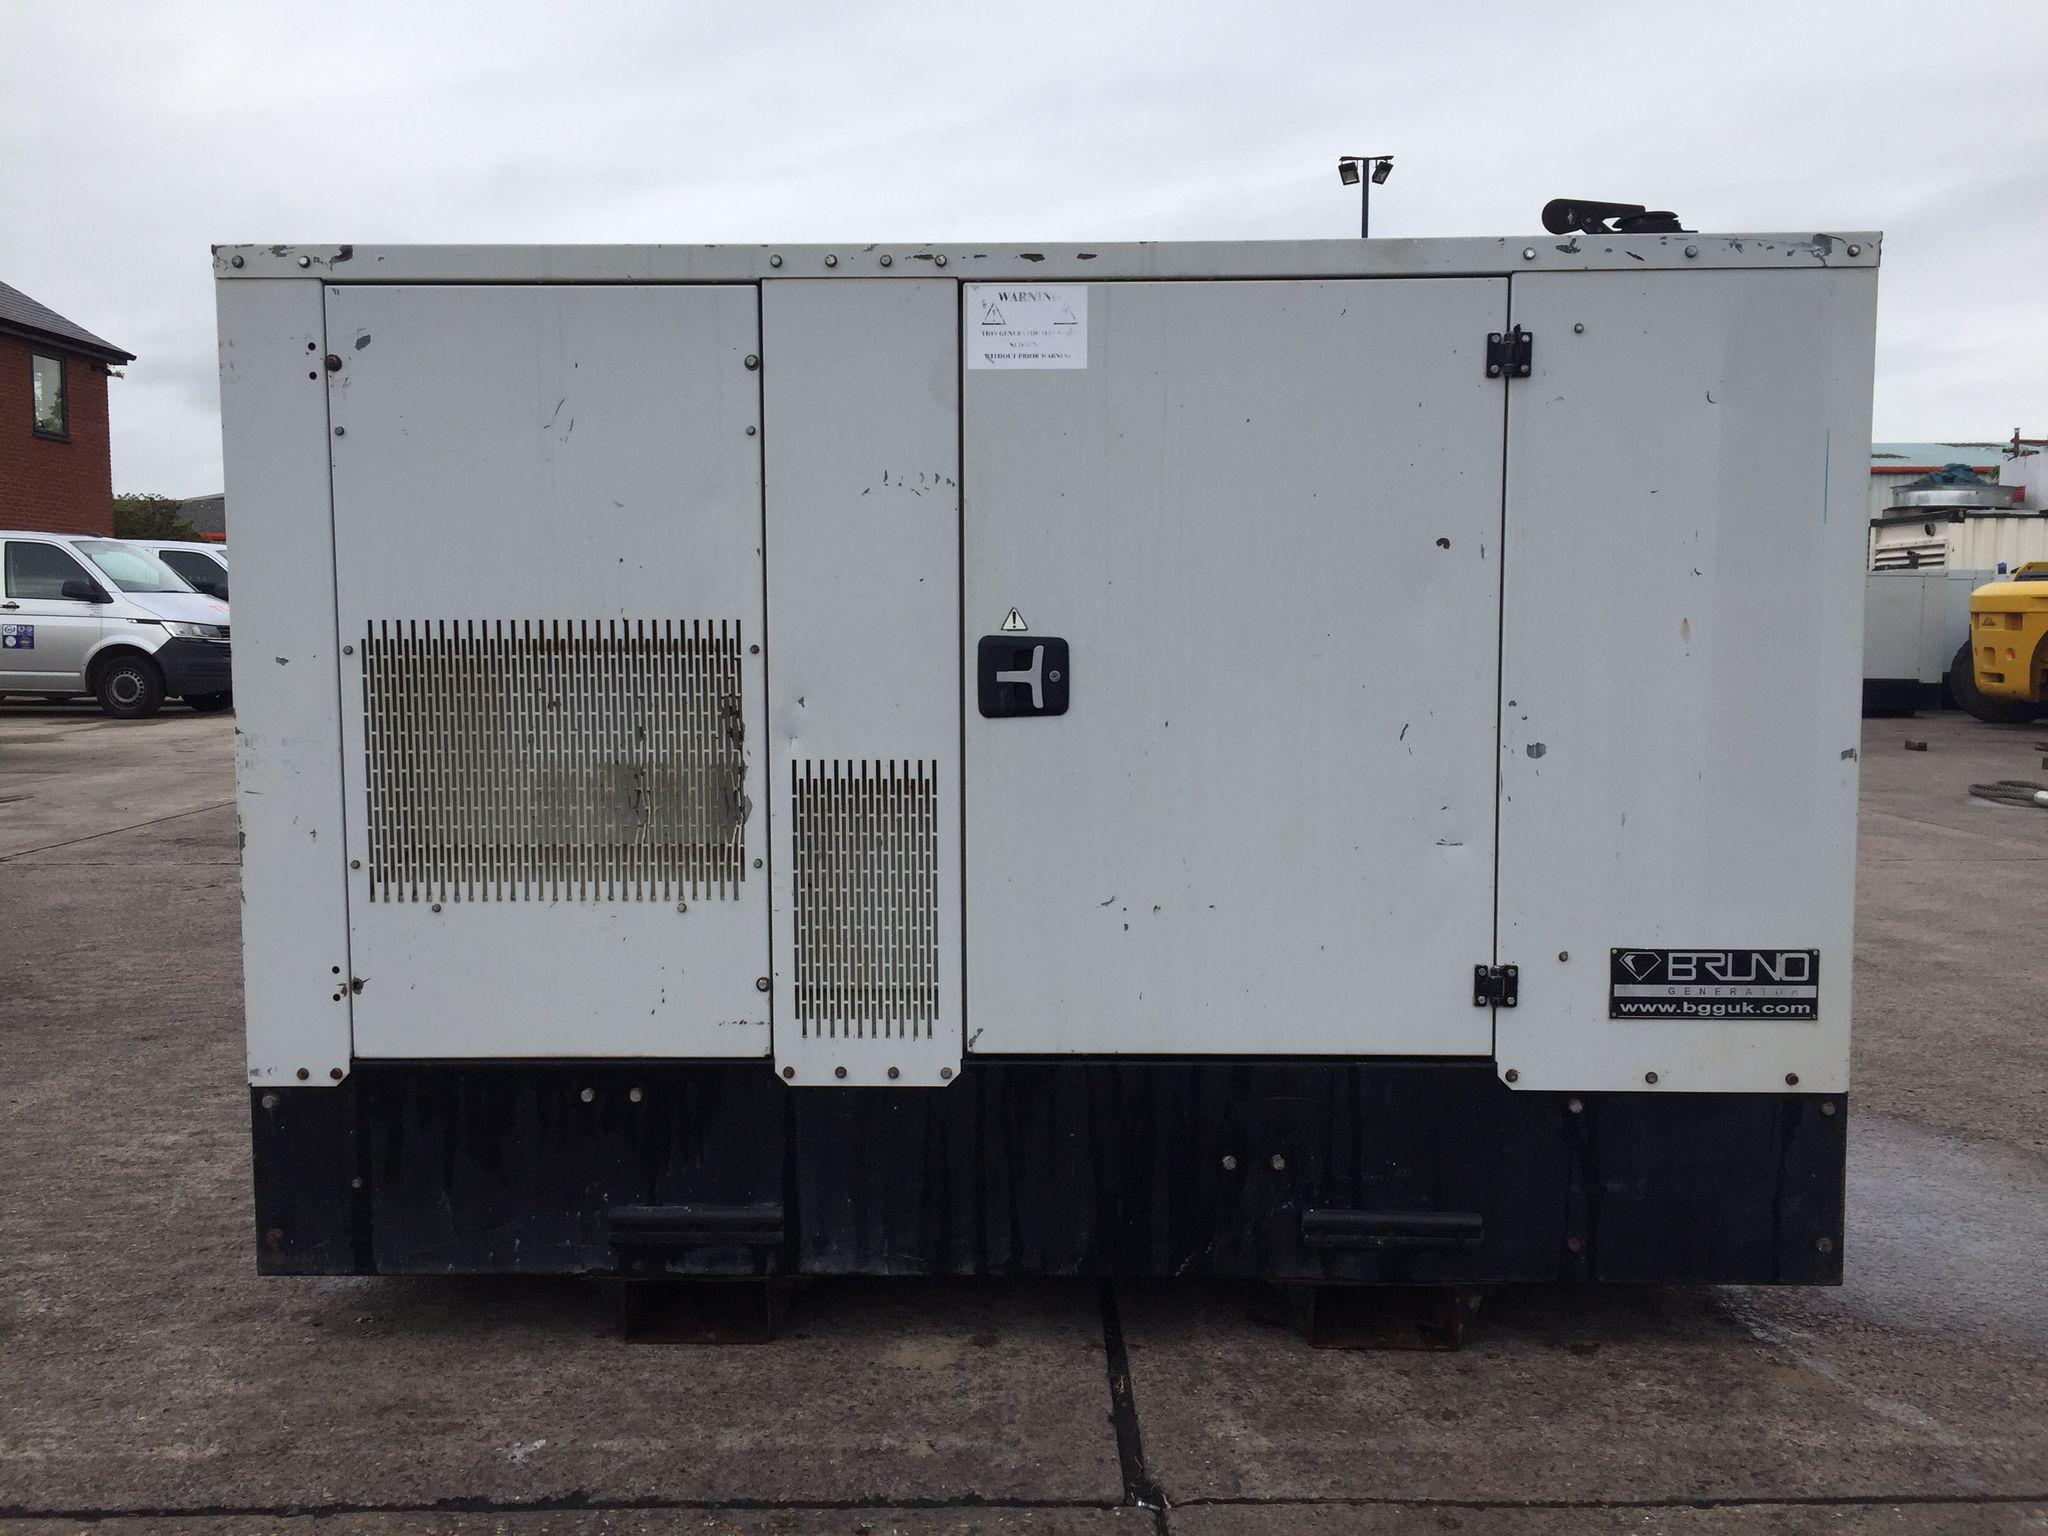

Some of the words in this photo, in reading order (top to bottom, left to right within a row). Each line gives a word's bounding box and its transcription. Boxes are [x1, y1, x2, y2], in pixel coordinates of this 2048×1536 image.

[998, 291, 1061, 302] WARNIN
[1668, 952, 1810, 982] BRUNO
[1619, 1002, 1811, 1016] www.bgguk.com
